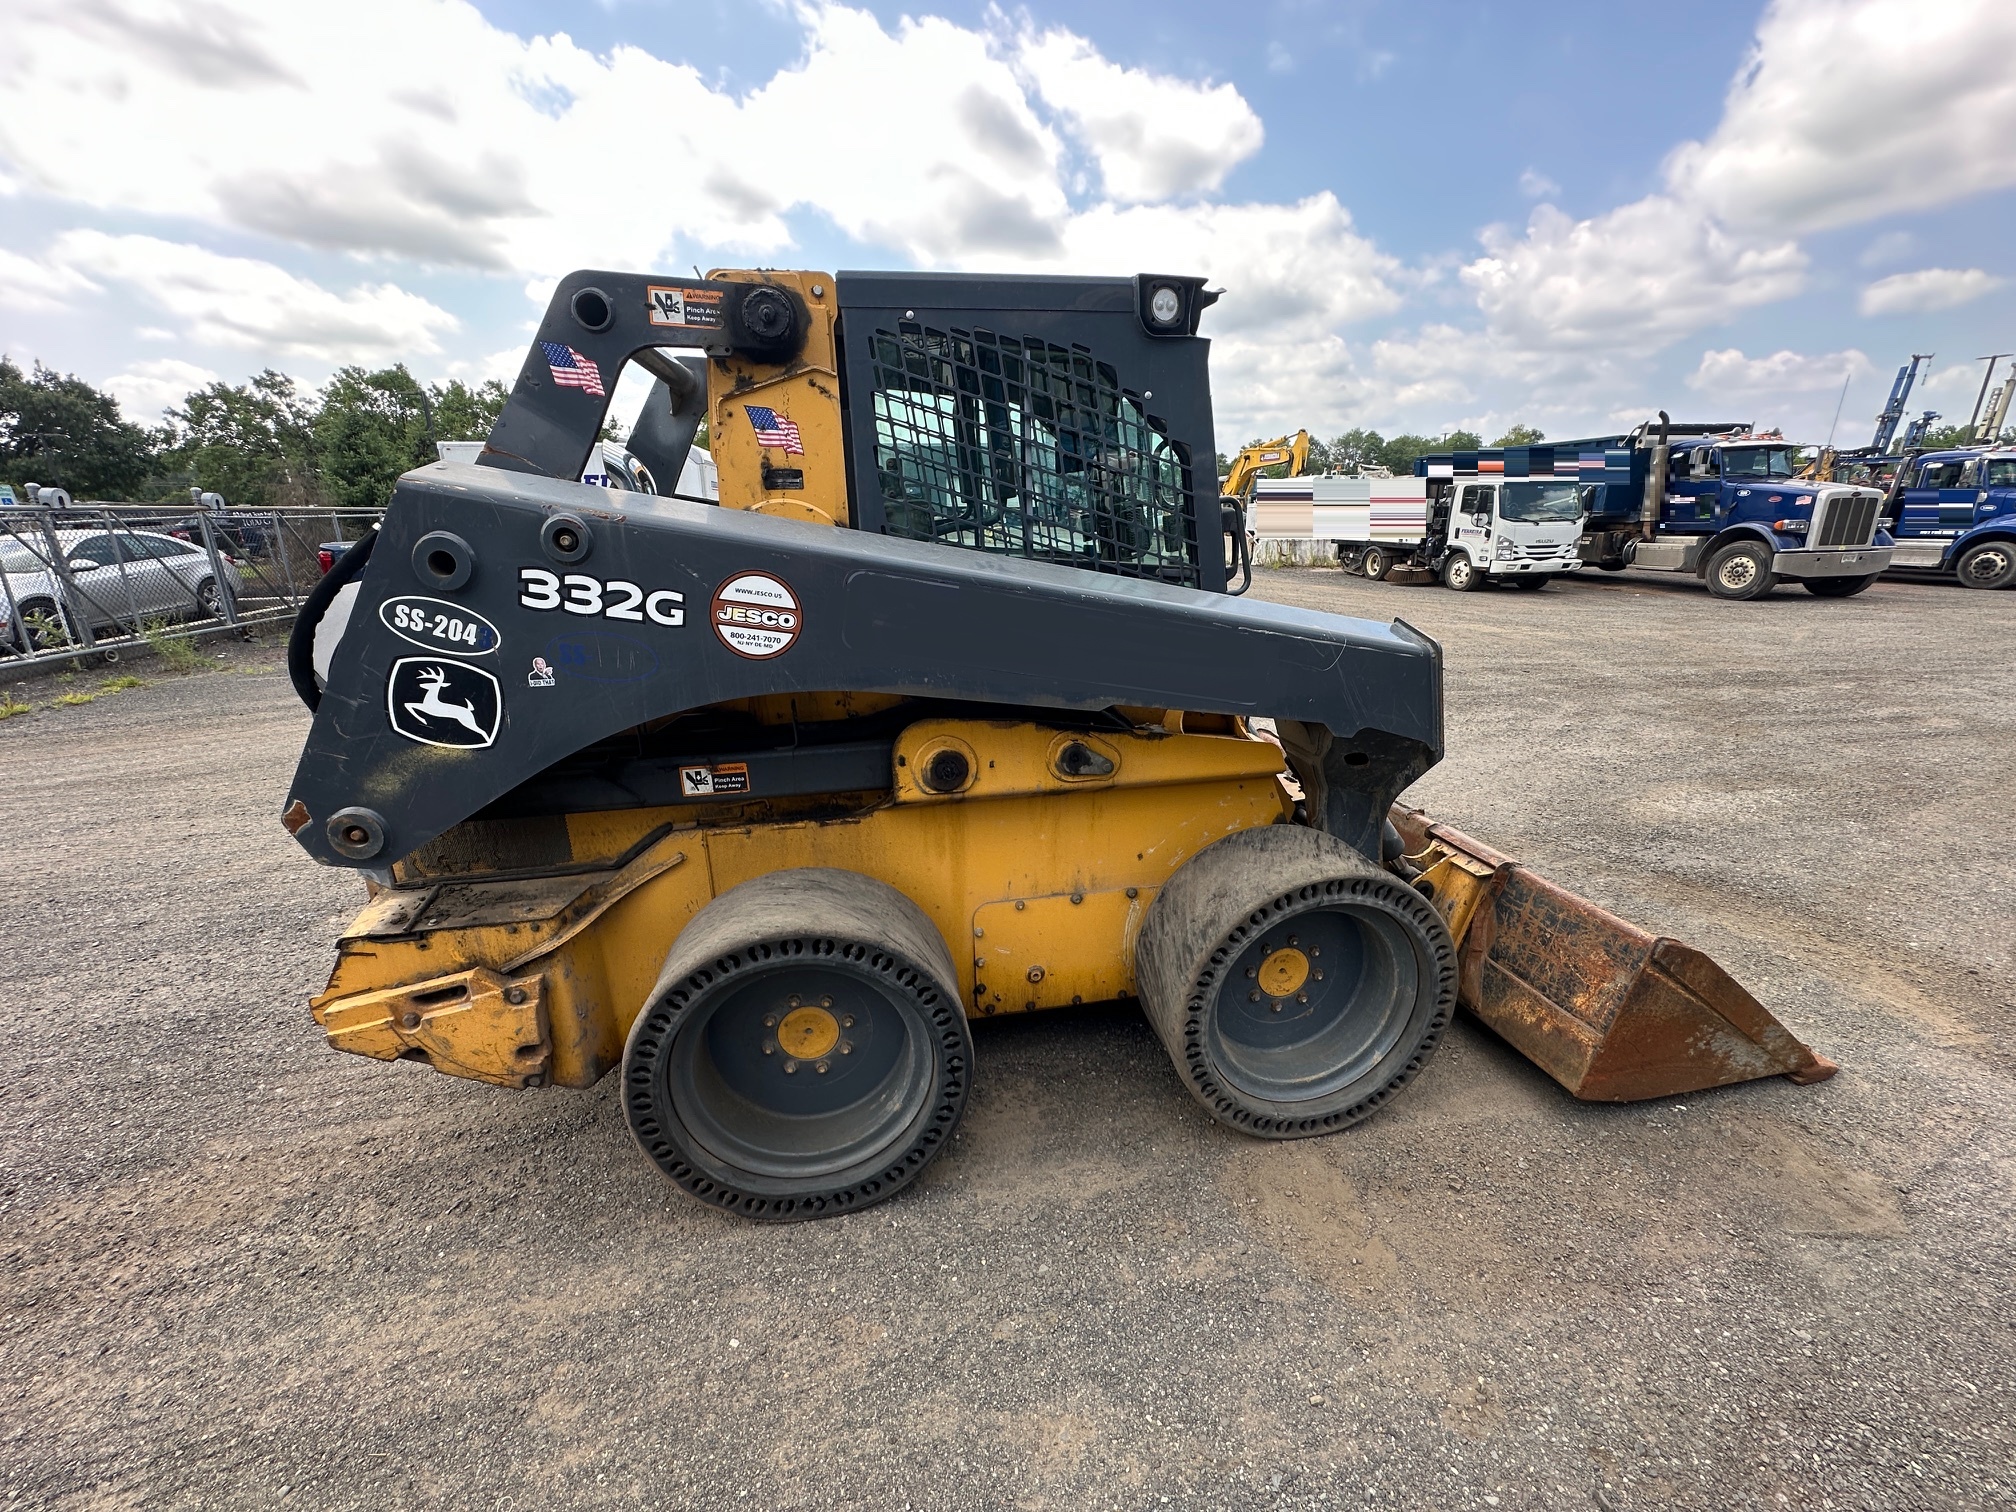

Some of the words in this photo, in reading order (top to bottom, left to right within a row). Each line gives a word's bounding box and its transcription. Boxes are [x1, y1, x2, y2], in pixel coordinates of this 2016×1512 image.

[686, 306, 704, 314] Pinch
[686, 314, 701, 322] Keep
[701, 315, 716, 323] Away
[520, 568, 684, 627] 332G
[734, 587, 782, 599] WWW.JESCO.US
[717, 605, 796, 629] JESCO
[730, 631, 781, 644] 800-241-7070
